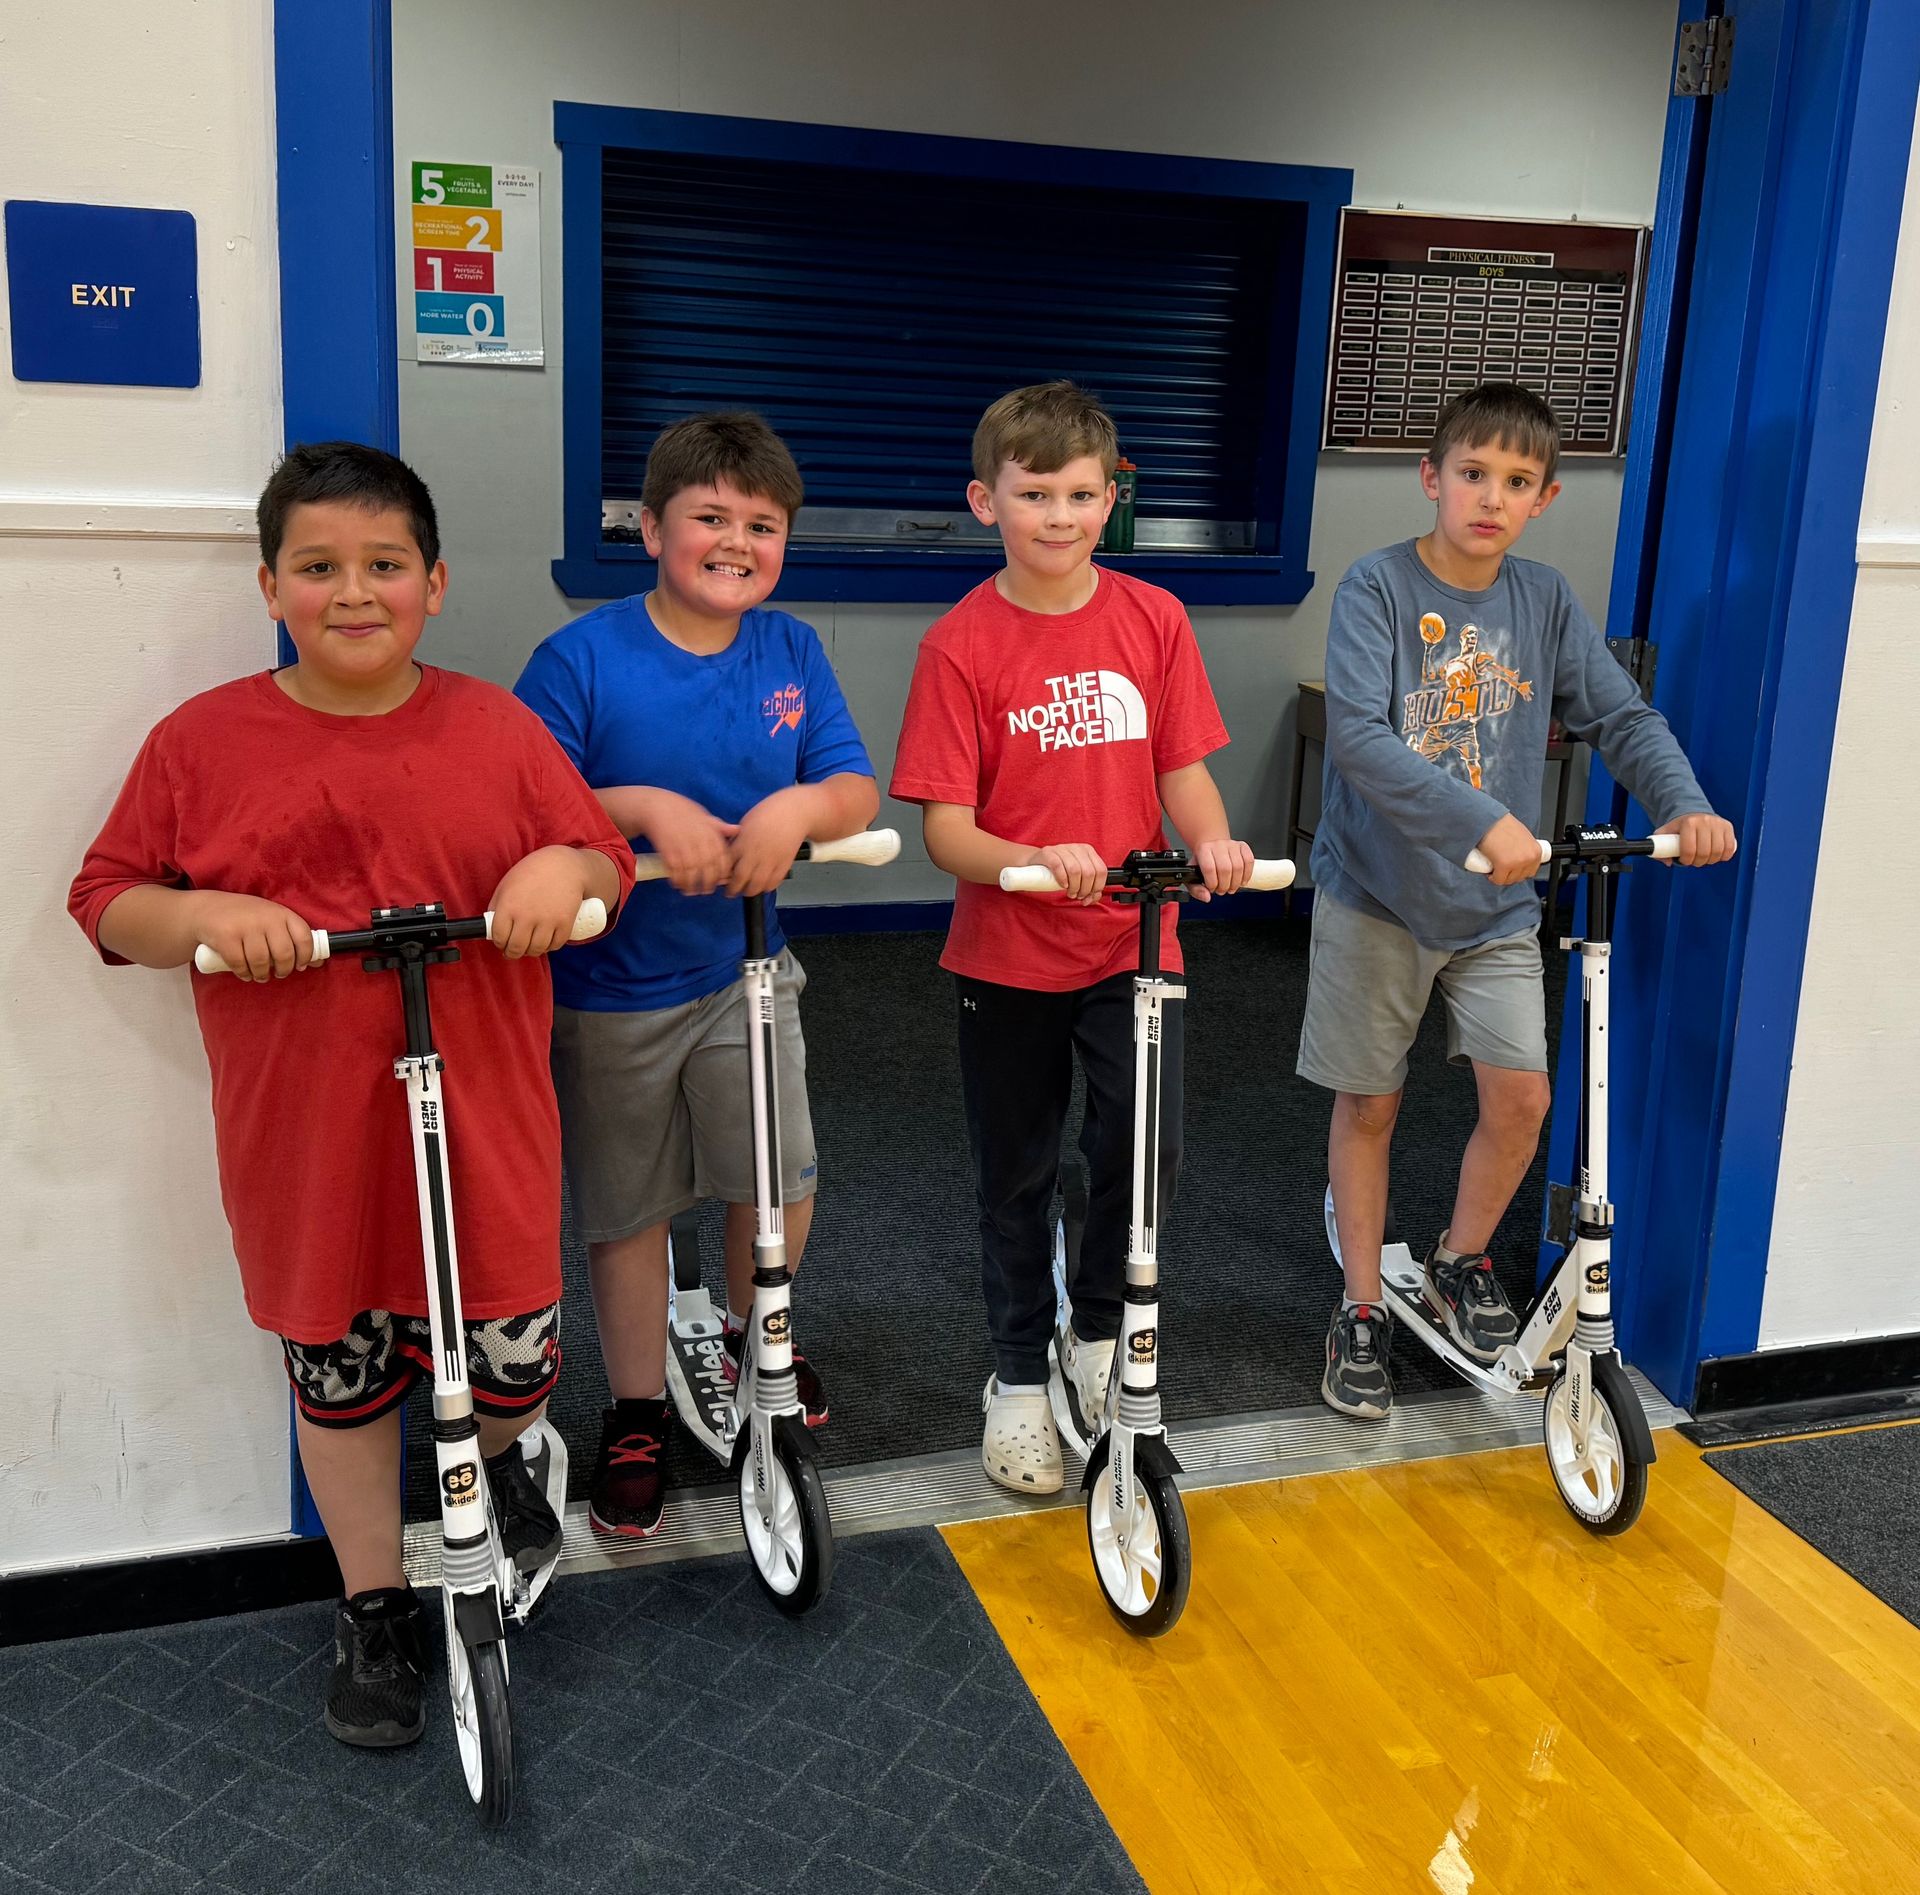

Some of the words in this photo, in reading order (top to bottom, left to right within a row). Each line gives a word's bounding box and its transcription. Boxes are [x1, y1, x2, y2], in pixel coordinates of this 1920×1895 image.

[421, 168, 446, 205] 5
[446, 186, 488, 195] VEGETABLES
[465, 215, 492, 252] 2
[453, 267, 485, 275] PHYSICAL
[1449, 251, 1498, 264] PHYSICAL
[1499, 254, 1536, 265] FITNESS
[1479, 266, 1504, 277] BOYS
[427, 256, 442, 292] 1
[71, 283, 136, 308] EXIT
[420, 311, 440, 319] MORE
[440, 312, 464, 320] WATER
[465, 302, 495, 337] 0
[1044, 670, 1100, 702] THE
[1007, 695, 1101, 736] NORTH
[1038, 719, 1105, 753] FACE
[420, 1100, 431, 1130] X3M
[1542, 1286, 1559, 1316] X3M
